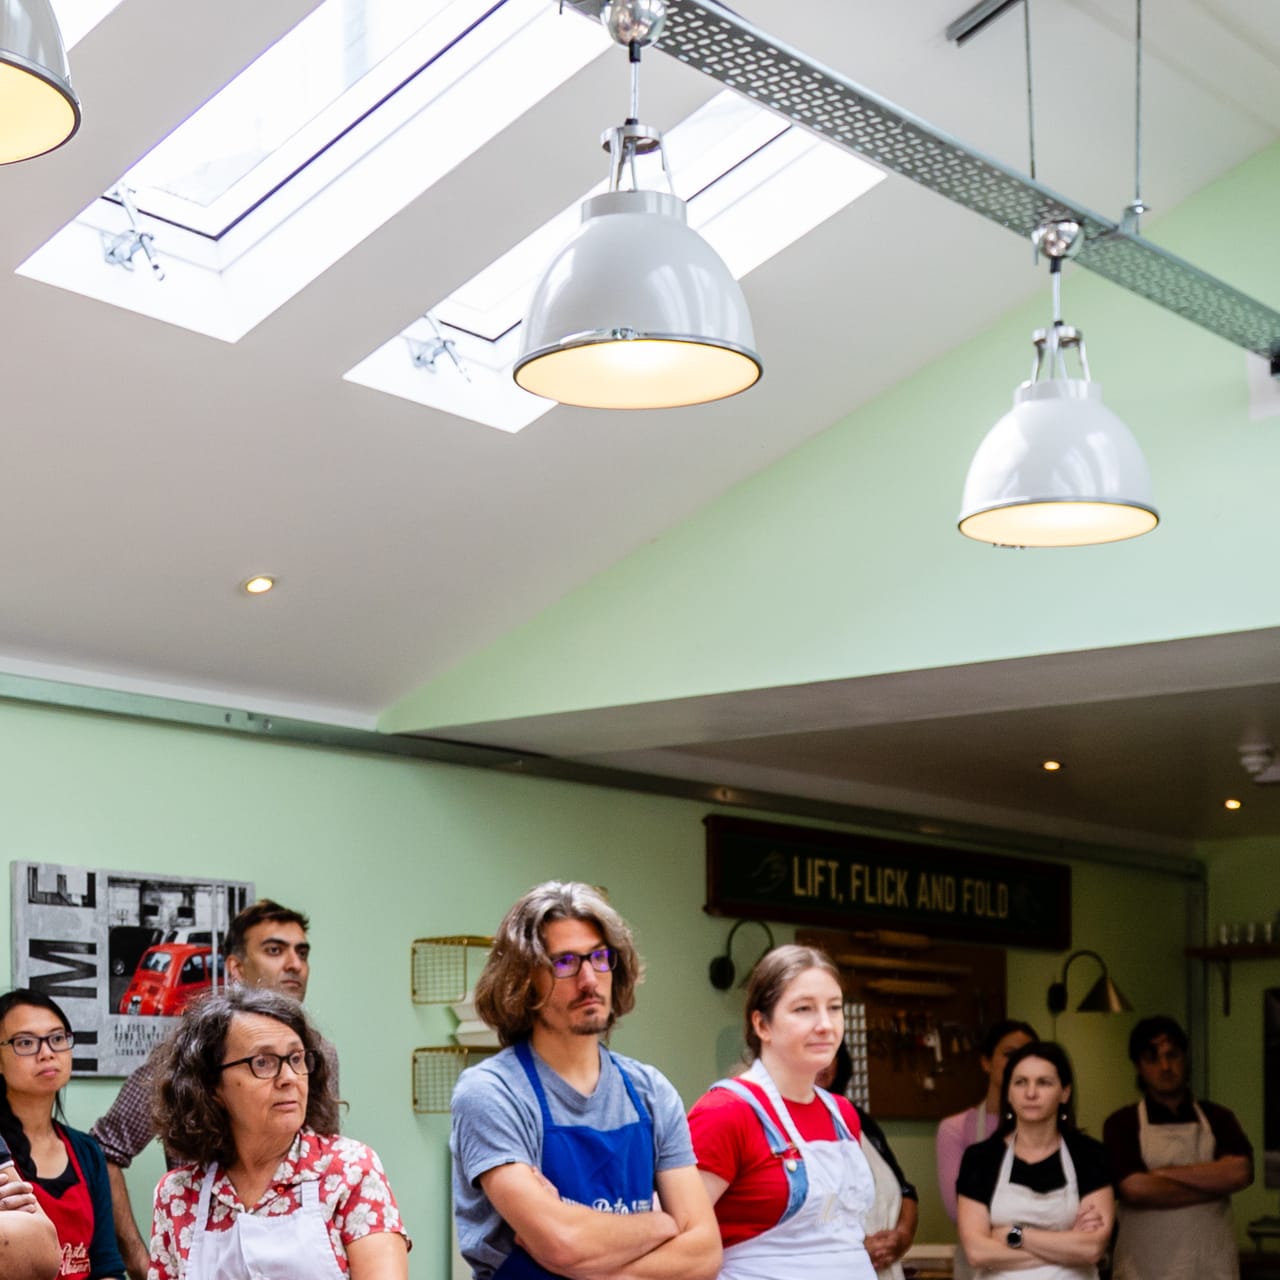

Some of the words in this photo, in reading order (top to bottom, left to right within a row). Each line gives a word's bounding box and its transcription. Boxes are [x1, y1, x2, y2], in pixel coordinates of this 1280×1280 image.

[793, 856, 843, 904] LIFT,
[850, 863, 910, 908] FLICK
[916, 871, 956, 912] AND
[963, 877, 1009, 918] FOLD
